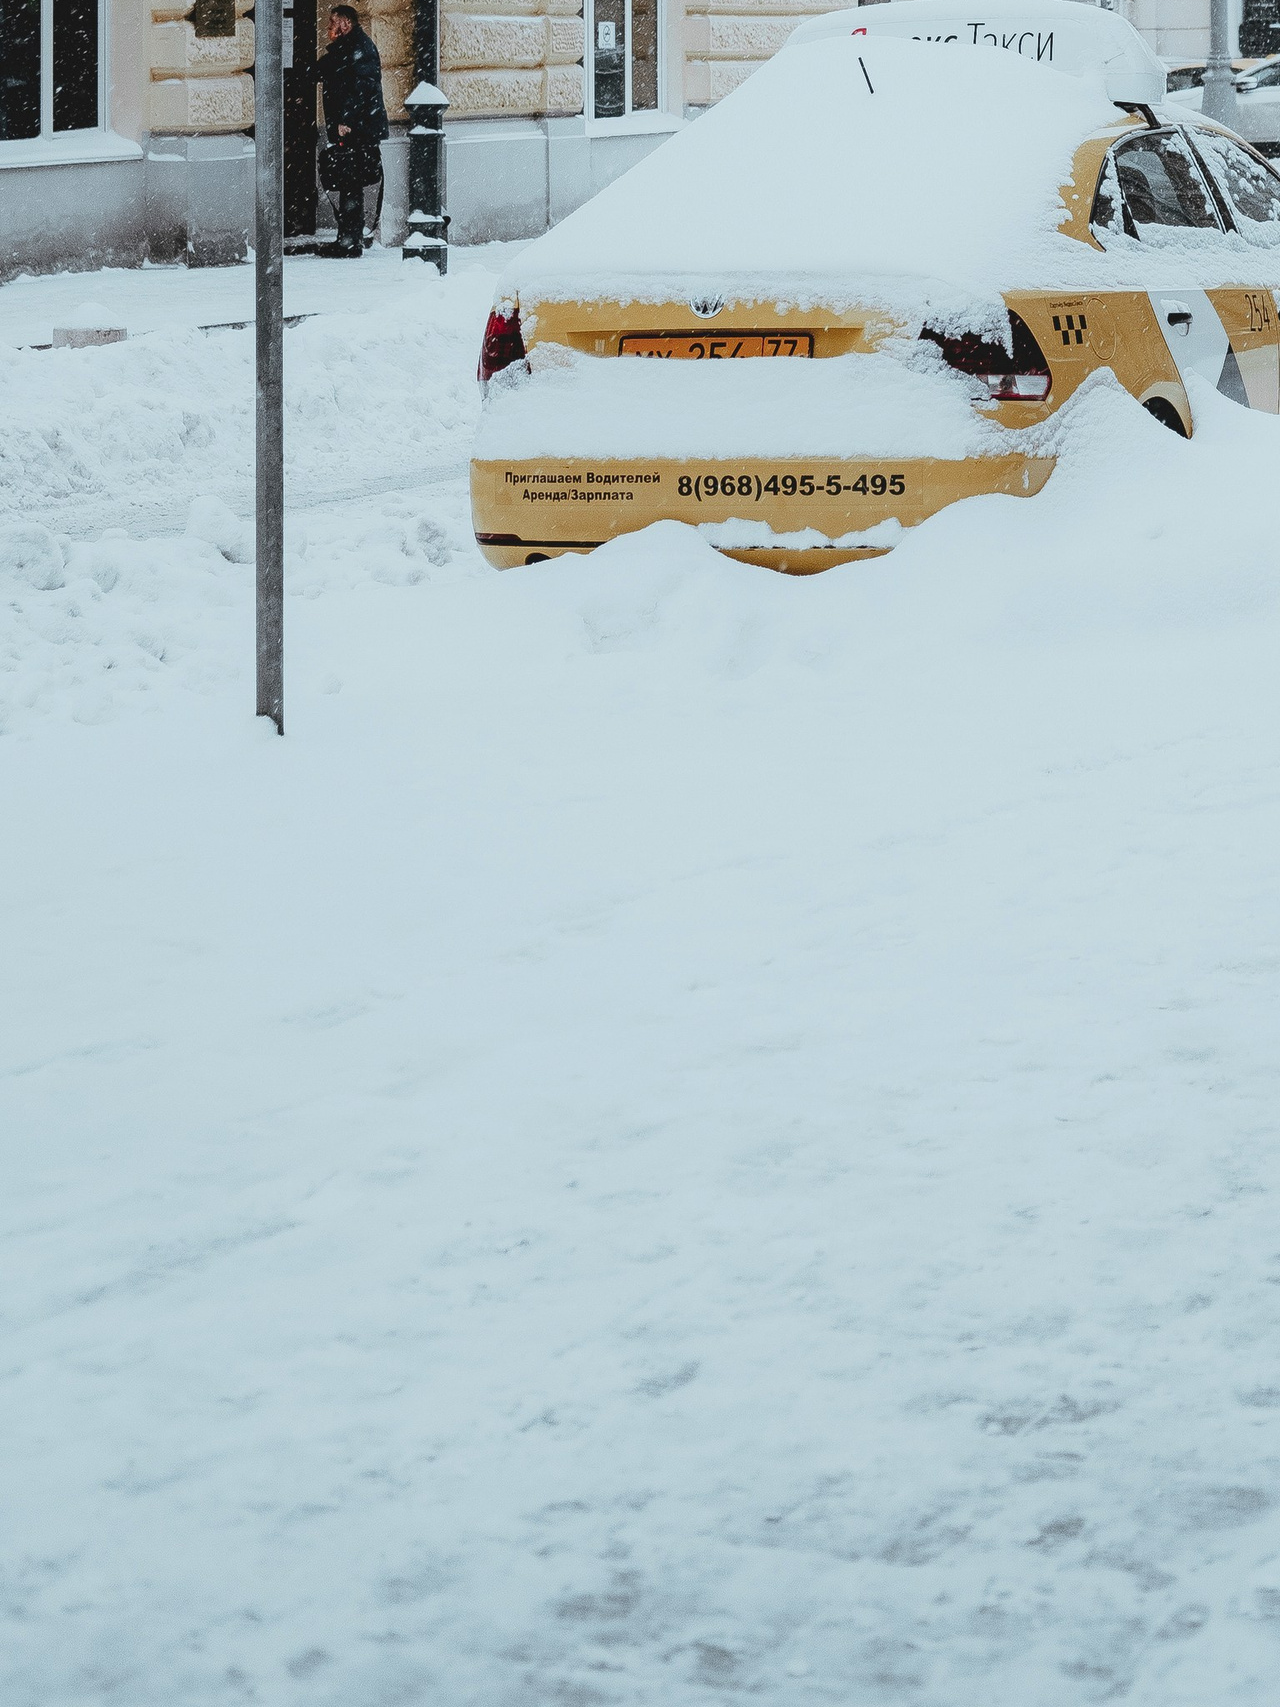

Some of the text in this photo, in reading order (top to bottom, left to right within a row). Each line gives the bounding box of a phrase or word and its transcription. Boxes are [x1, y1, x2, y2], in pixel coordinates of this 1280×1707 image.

[1245, 294, 1270, 332] 254
[505, 472, 661, 485] Приглашаем Водителей
[678, 475, 906, 501] 8(968)495-5-495
[522, 489, 634, 503] Аренда/Зарплата
